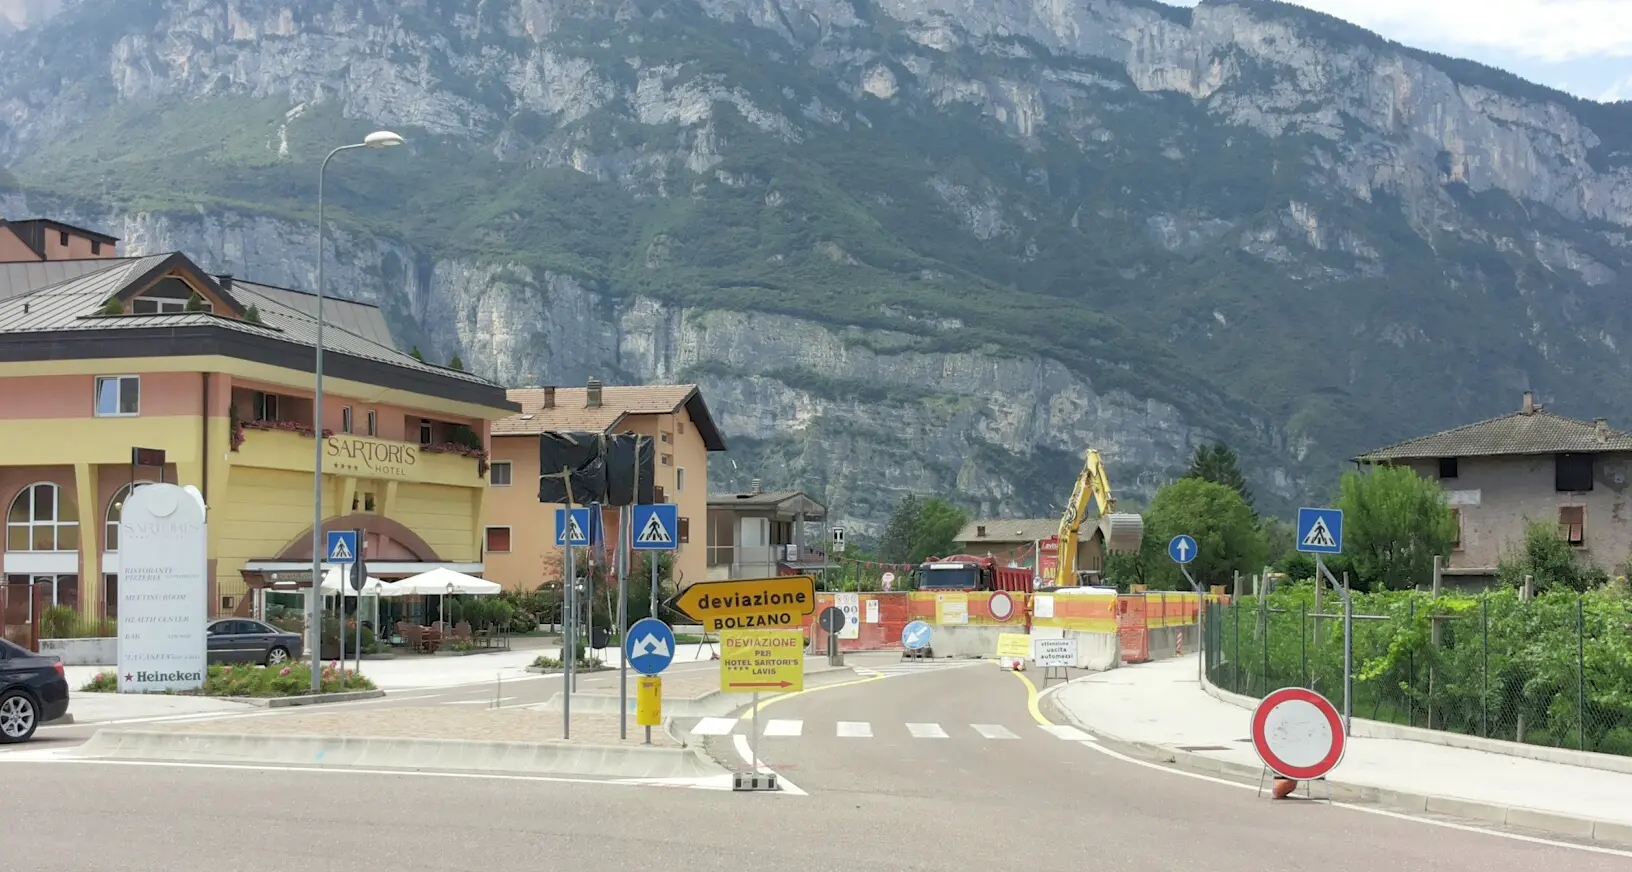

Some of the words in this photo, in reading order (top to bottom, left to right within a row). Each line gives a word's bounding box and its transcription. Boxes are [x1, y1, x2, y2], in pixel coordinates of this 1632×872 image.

[327, 437, 416, 469] SARTORI'S
[375, 465, 406, 475] HOTEL
[698, 591, 806, 610] deviazione
[157, 615, 189, 623] CENTER
[714, 613, 791, 630] BOLZANO
[726, 638, 797, 648] DEVIAZIONE
[725, 659, 752, 667] HOTEL
[754, 659, 799, 667] SARTORI'S
[137, 670, 202, 682] Heineken
